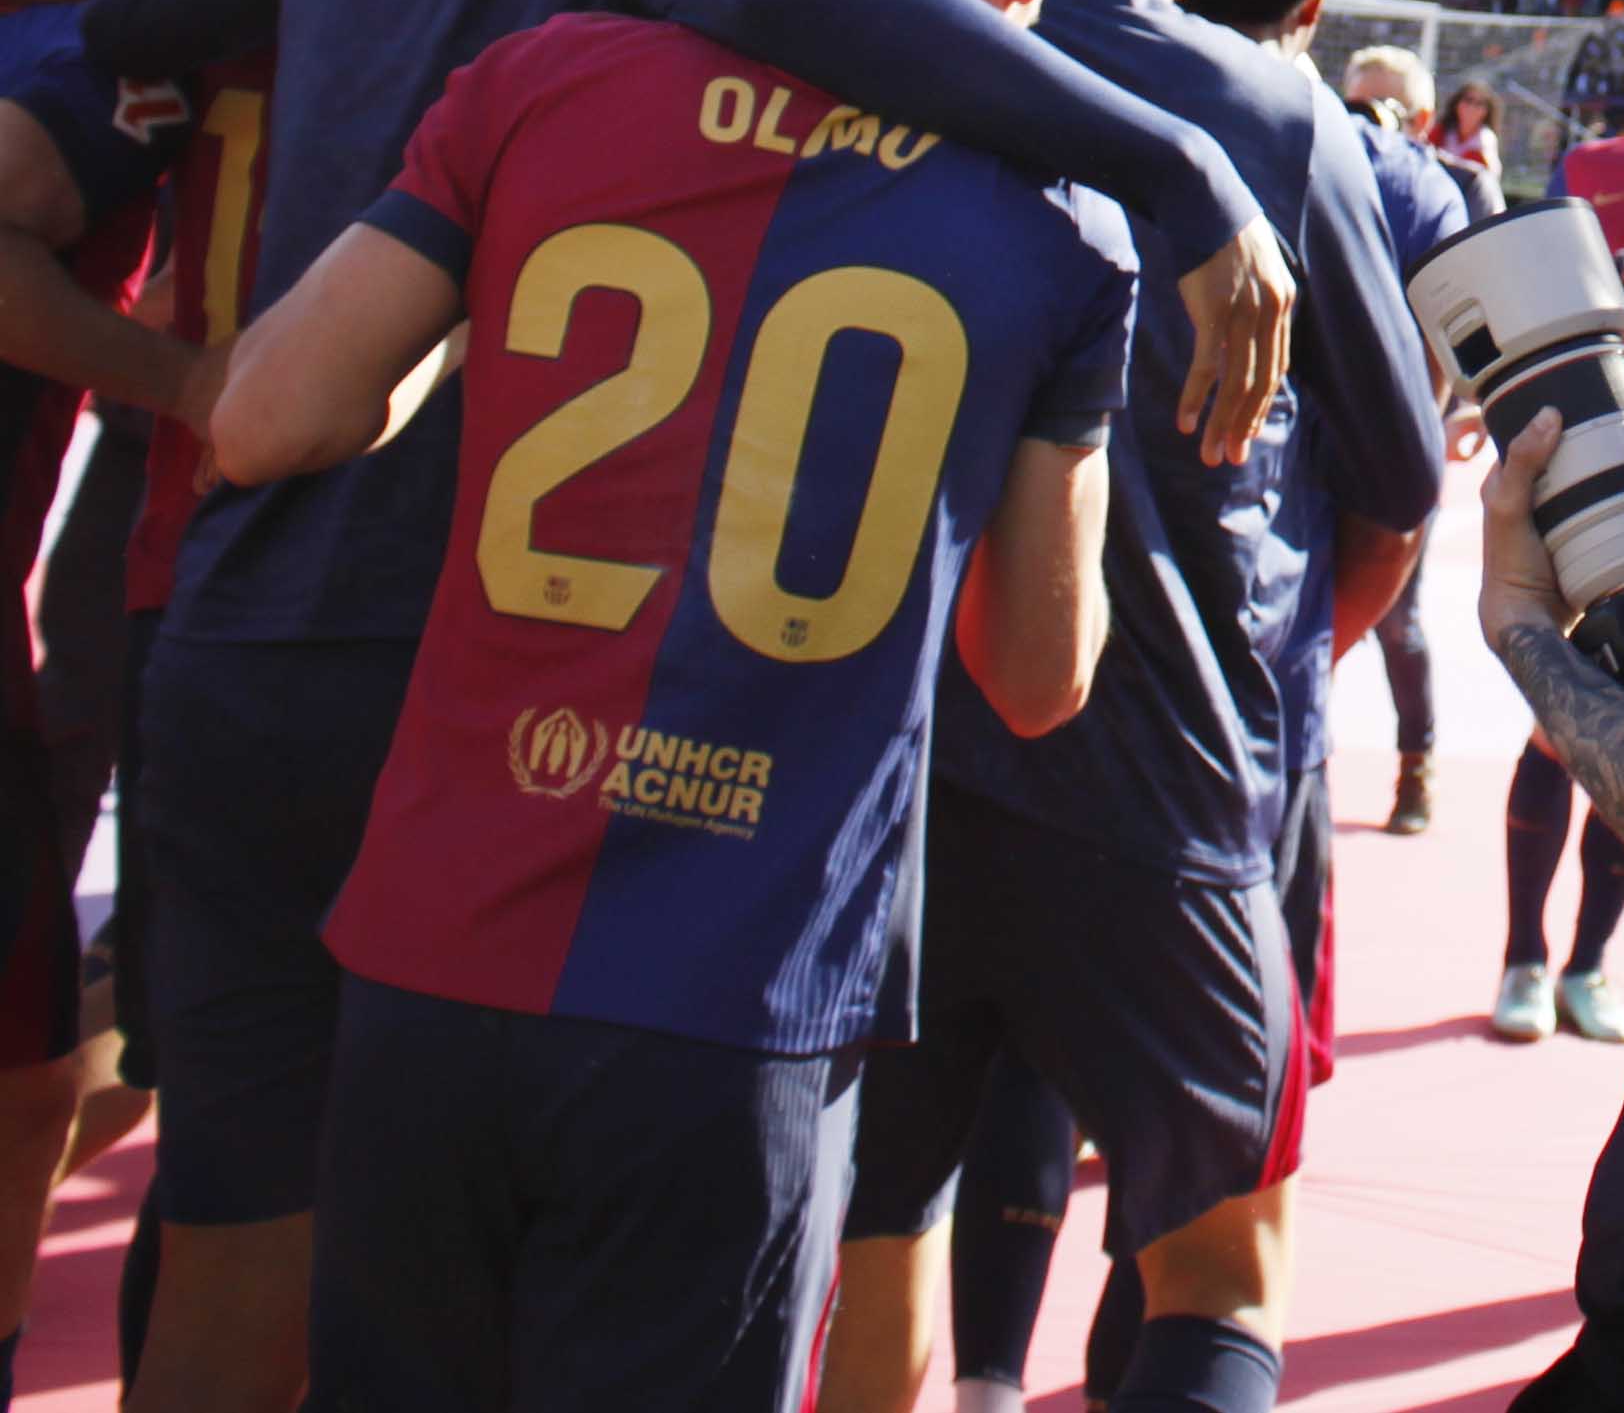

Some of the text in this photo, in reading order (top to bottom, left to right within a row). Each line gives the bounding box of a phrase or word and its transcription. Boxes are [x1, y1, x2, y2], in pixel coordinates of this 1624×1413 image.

[475, 223, 970, 663] 20
[615, 724, 773, 788] UNHCR
[601, 761, 764, 823] ACNUR
